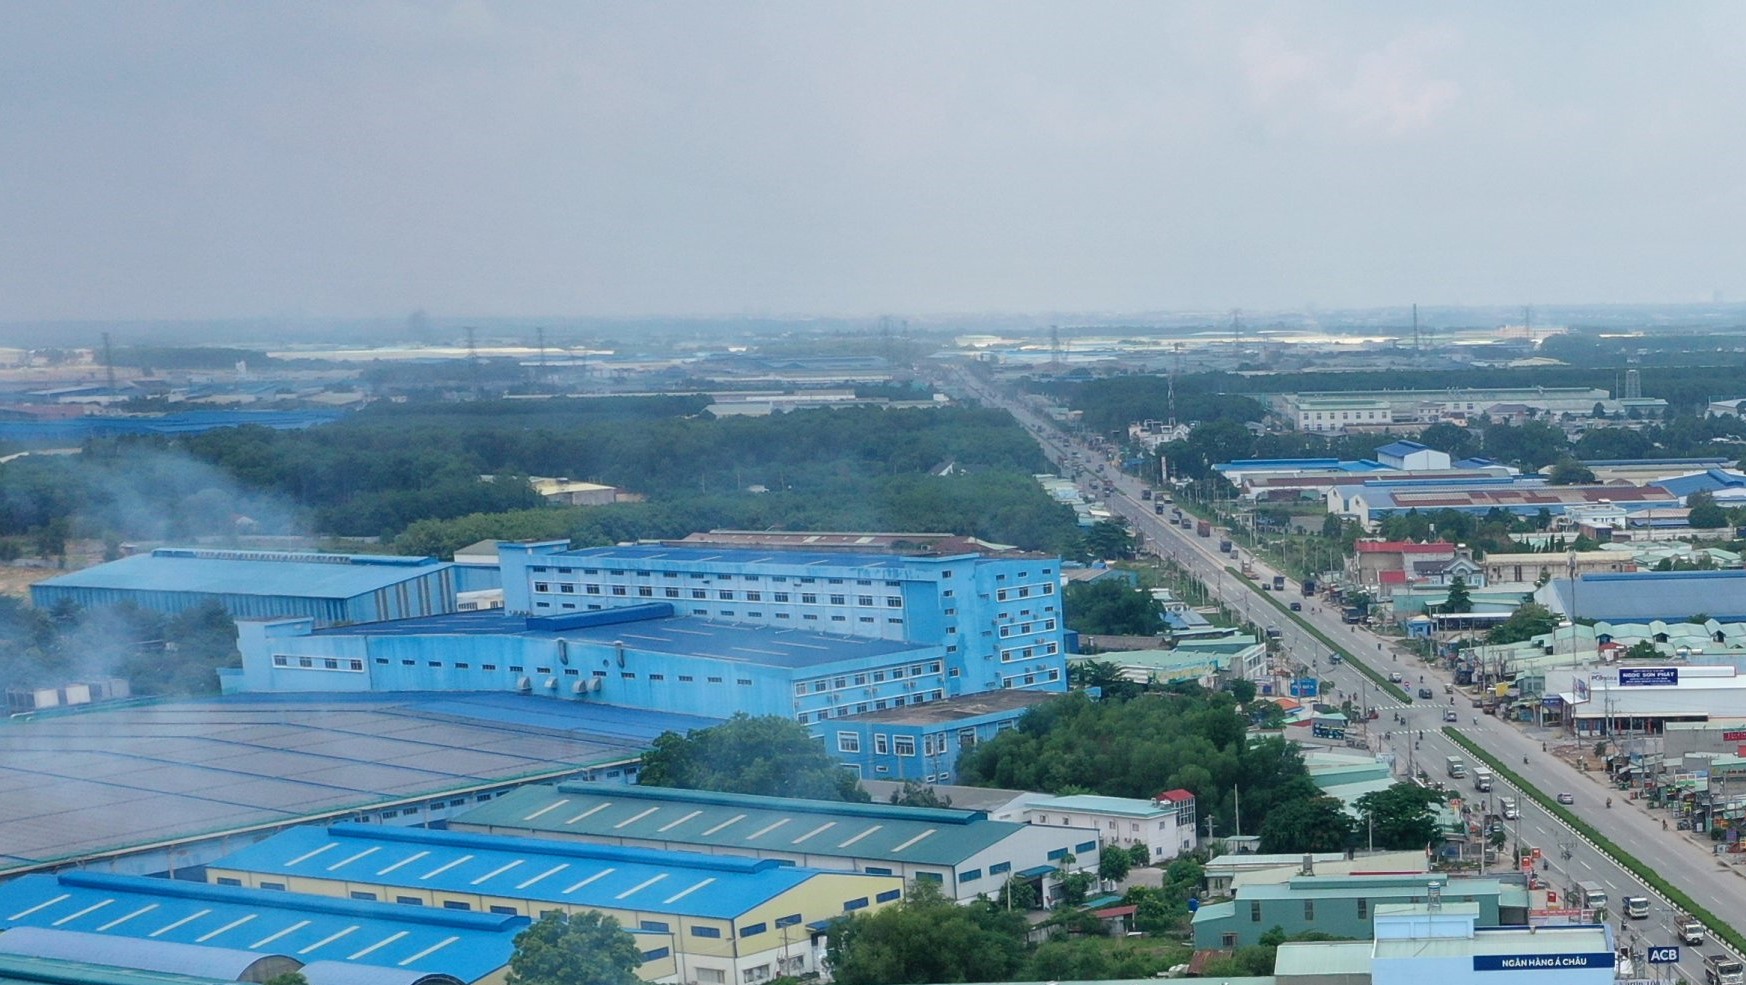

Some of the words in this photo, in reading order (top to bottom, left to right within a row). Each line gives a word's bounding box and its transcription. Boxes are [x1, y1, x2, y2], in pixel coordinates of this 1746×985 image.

[1651, 949, 1677, 961] ACB
[1502, 957, 1527, 968] NGÂN
[1528, 956, 1554, 967] HÀNG
[1554, 956, 1562, 966] Á
[1563, 956, 1588, 966] CHÂU
